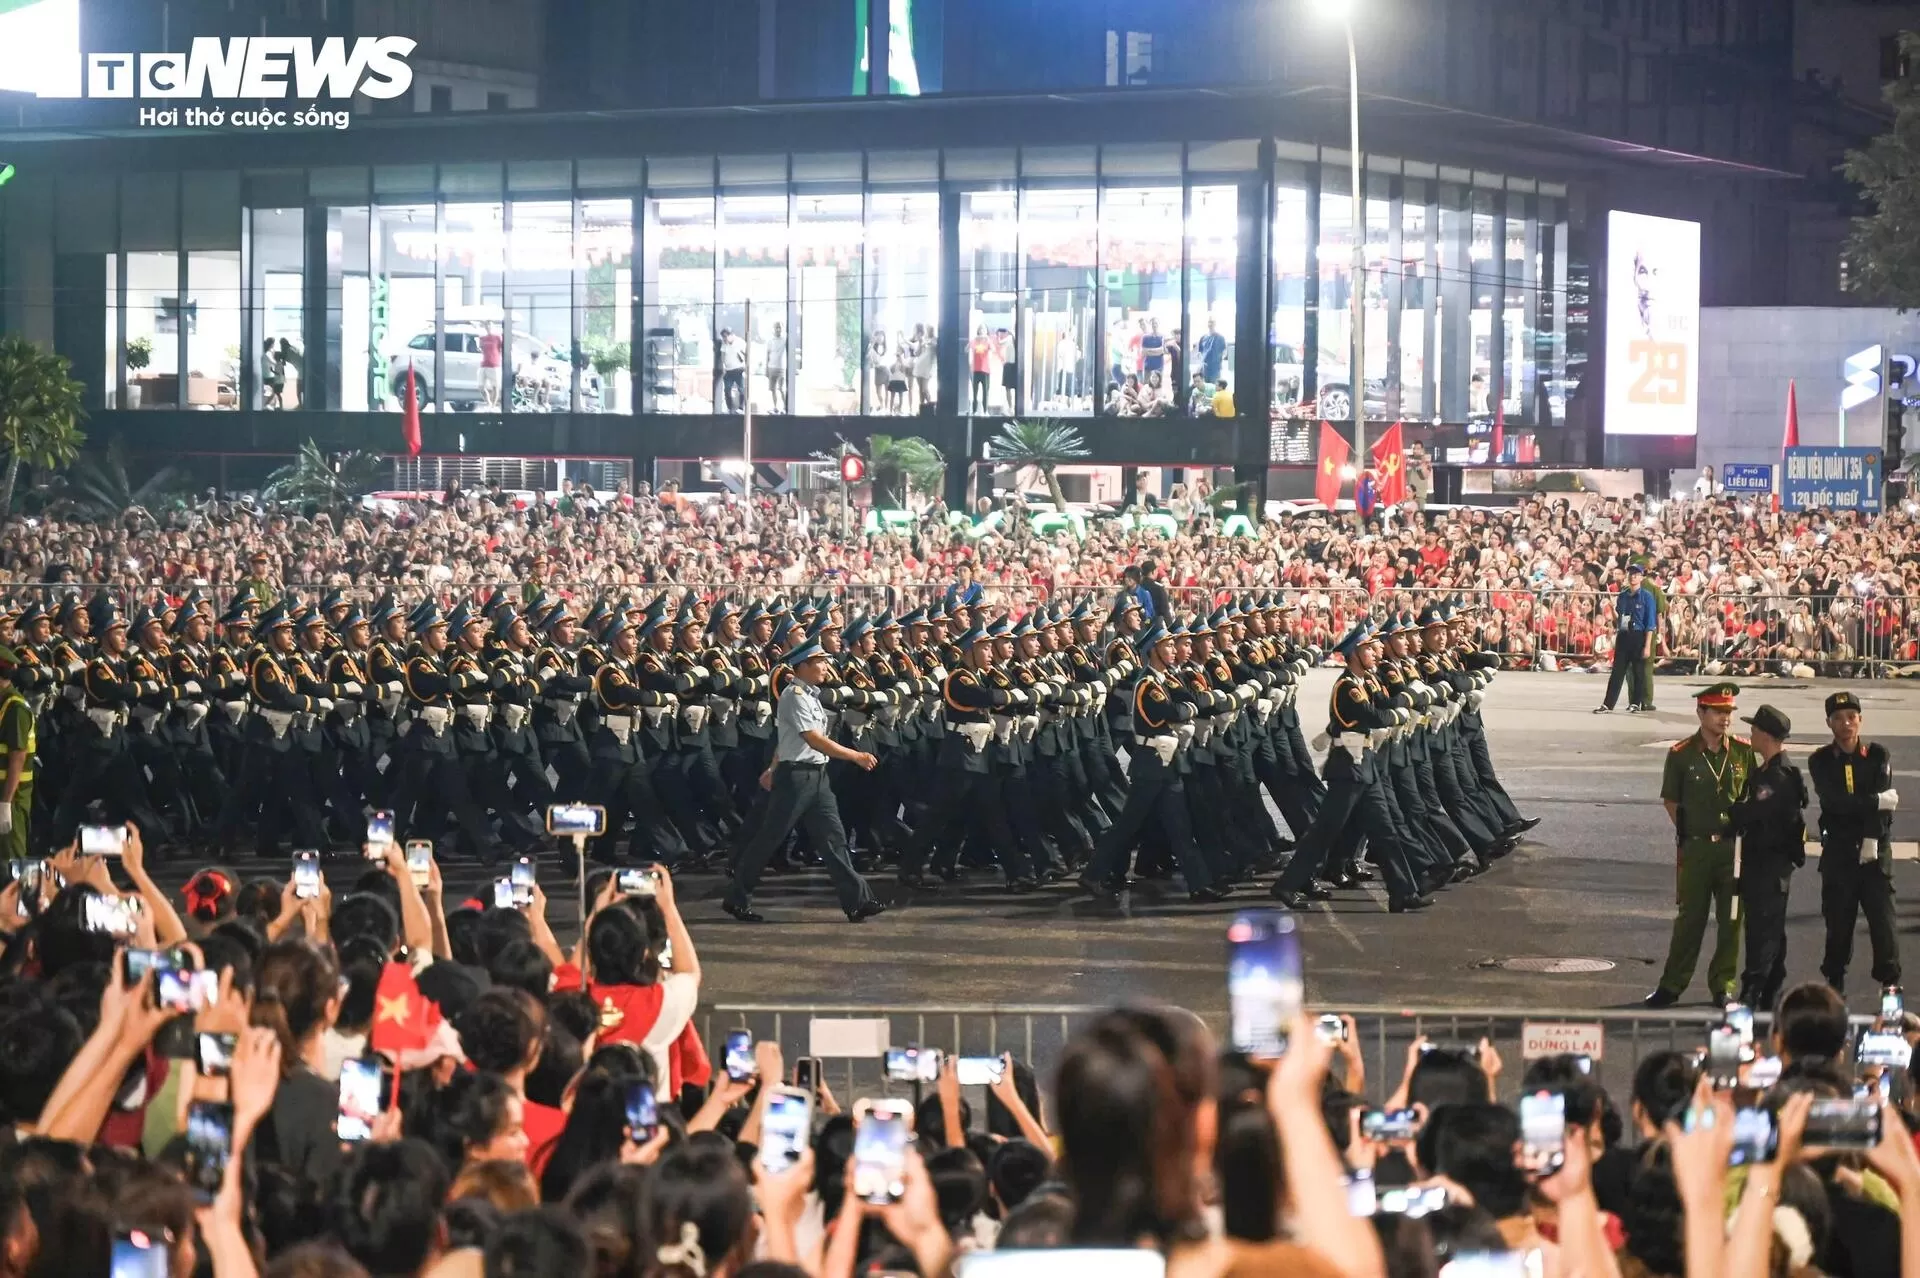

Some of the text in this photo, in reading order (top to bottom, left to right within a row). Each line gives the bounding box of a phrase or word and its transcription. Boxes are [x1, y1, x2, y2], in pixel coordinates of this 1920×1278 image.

[1628, 340, 1688, 404] 29
[1788, 450, 1806, 485] BỆNH
[1807, 450, 1823, 485] VIỆN
[1824, 450, 1843, 482] QUÂN
[1844, 456, 1849, 480] Y
[1749, 477, 1768, 488] GIAI
[1791, 491, 1809, 506] 120
